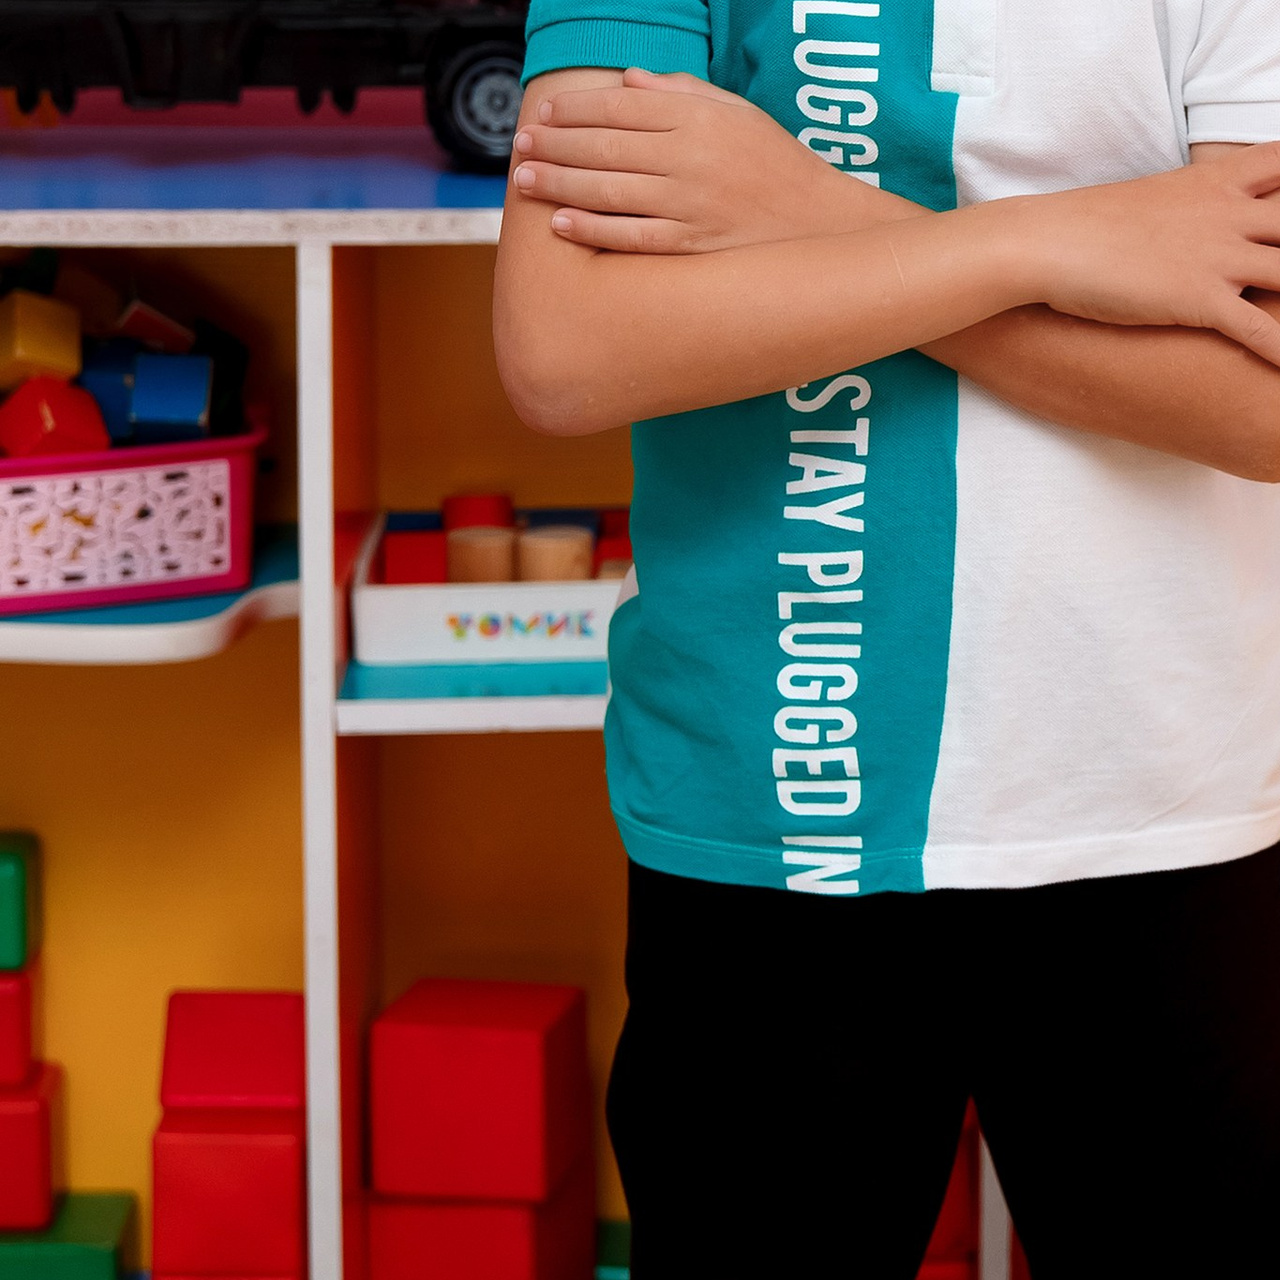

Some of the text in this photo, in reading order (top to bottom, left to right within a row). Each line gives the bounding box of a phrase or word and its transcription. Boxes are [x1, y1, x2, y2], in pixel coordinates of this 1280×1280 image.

[772, 374, 872, 895] STAY PLUGGED IN
